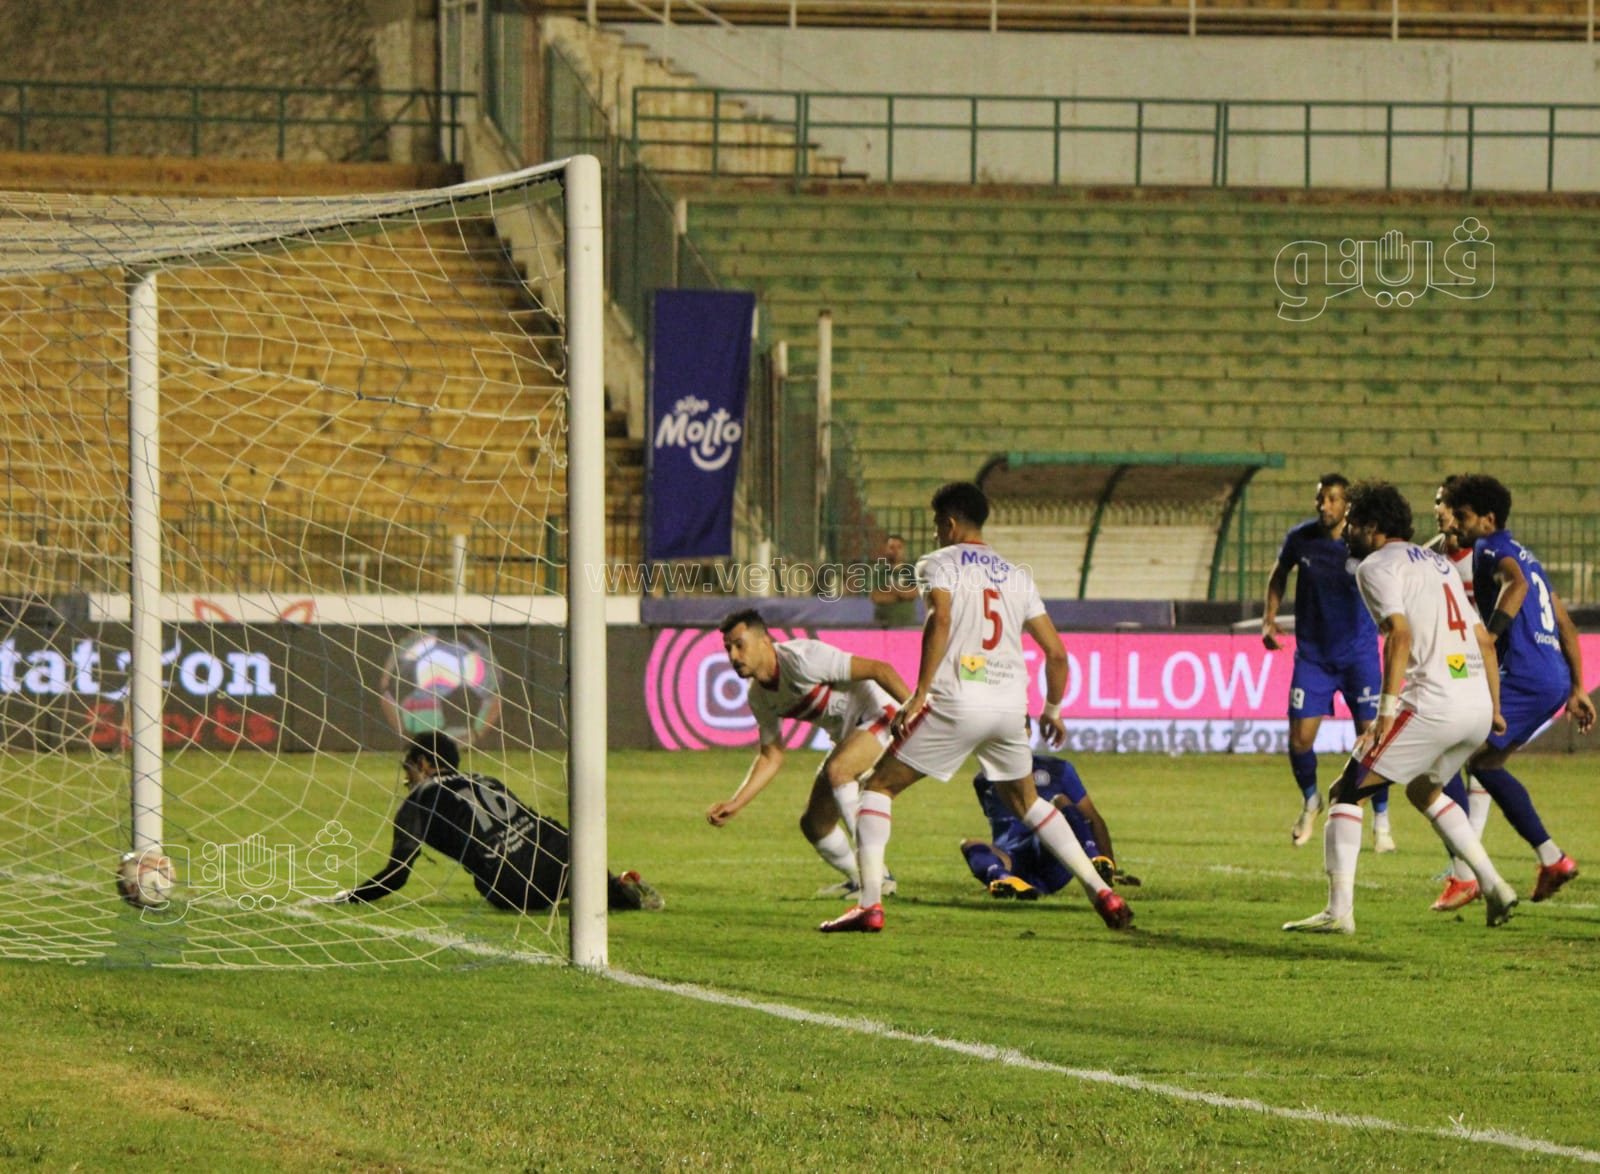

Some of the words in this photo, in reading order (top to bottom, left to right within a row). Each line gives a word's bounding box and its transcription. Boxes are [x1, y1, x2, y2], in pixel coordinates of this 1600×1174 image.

[655, 408, 742, 457] Molto
[982, 588, 1003, 651] 5
[1443, 582, 1467, 641] 4
[1531, 571, 1555, 632] 3
[0, 637, 277, 700] taton
[1023, 651, 1274, 710] OLLOW
